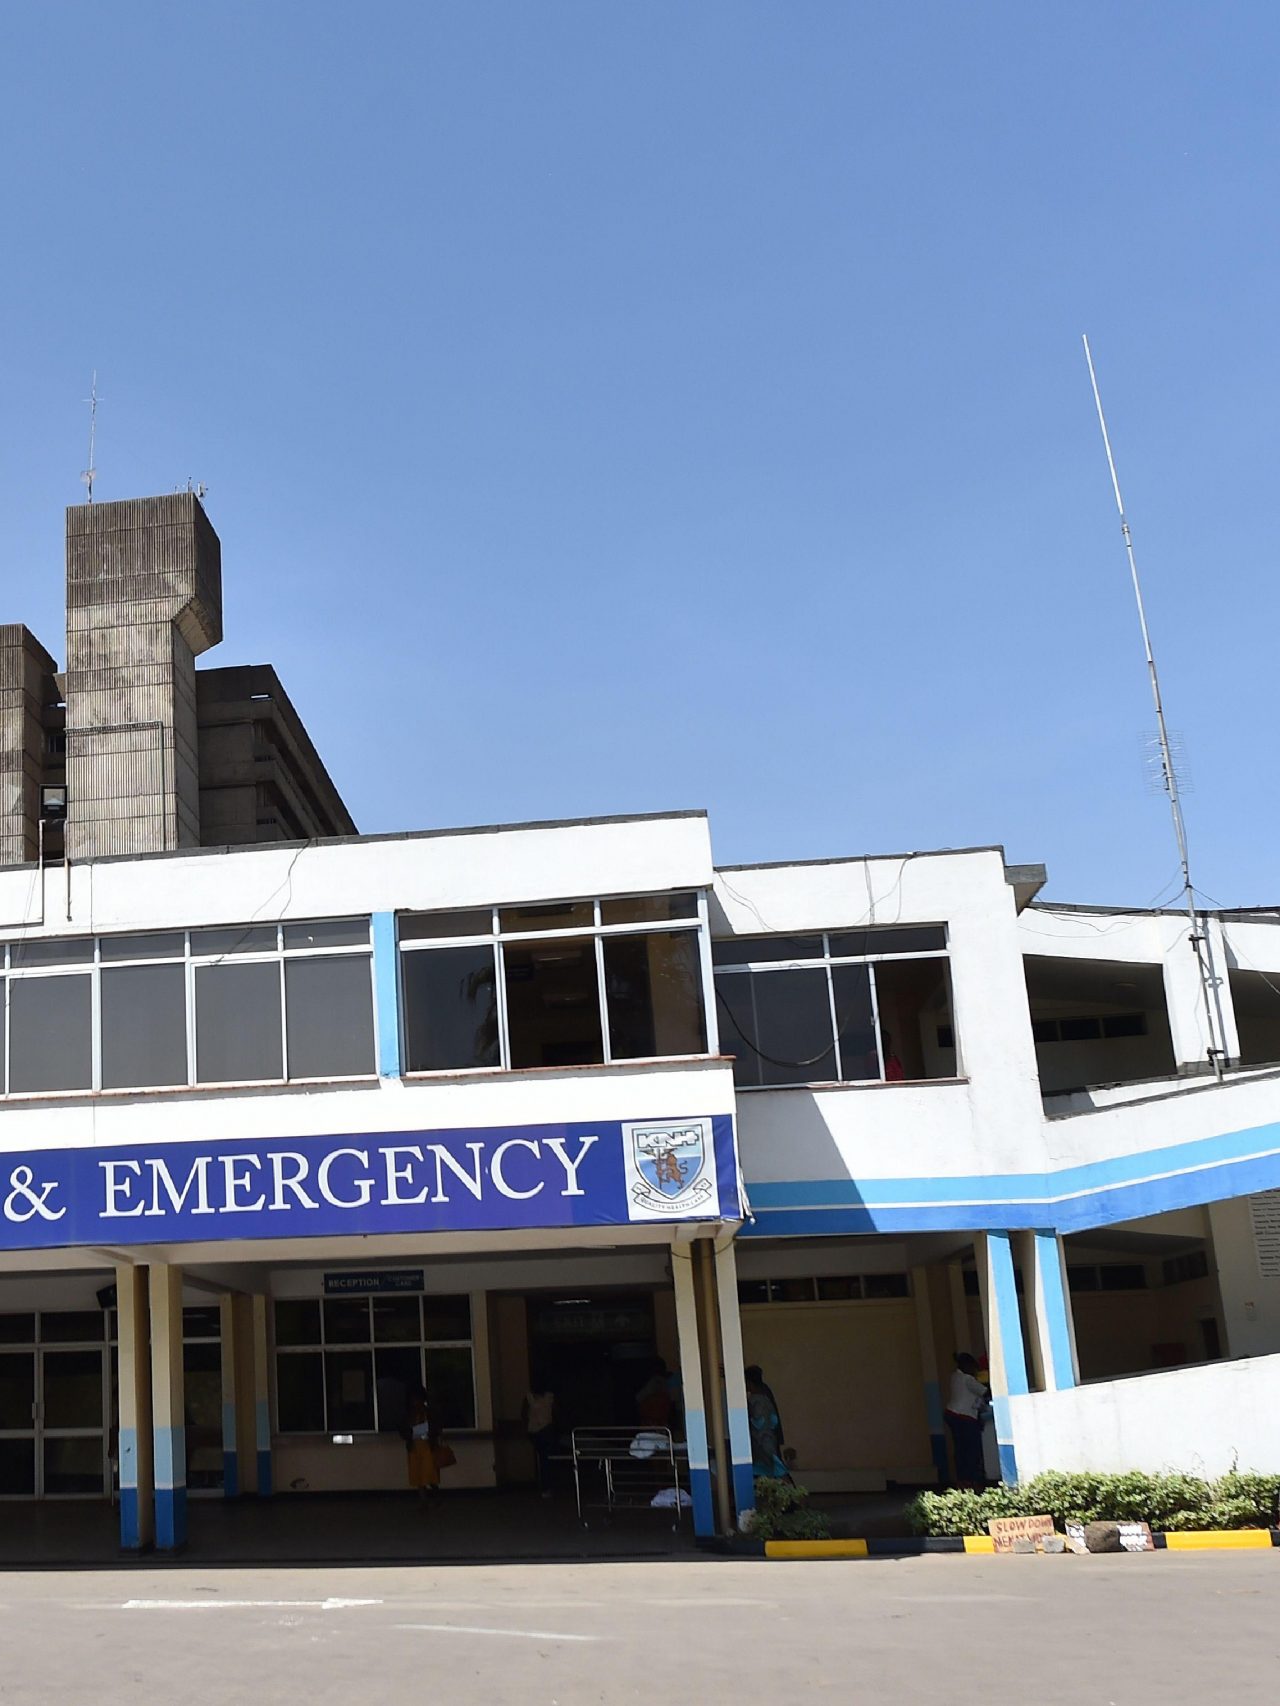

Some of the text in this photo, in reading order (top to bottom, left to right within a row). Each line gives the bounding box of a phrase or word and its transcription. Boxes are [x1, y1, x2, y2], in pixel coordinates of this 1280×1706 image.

[3, 1165, 67, 1222] &
[98, 1135, 599, 1218] EMERGENCY
[328, 1278, 379, 1289] RECEPTION
[996, 1520, 1026, 1534] SLOW
